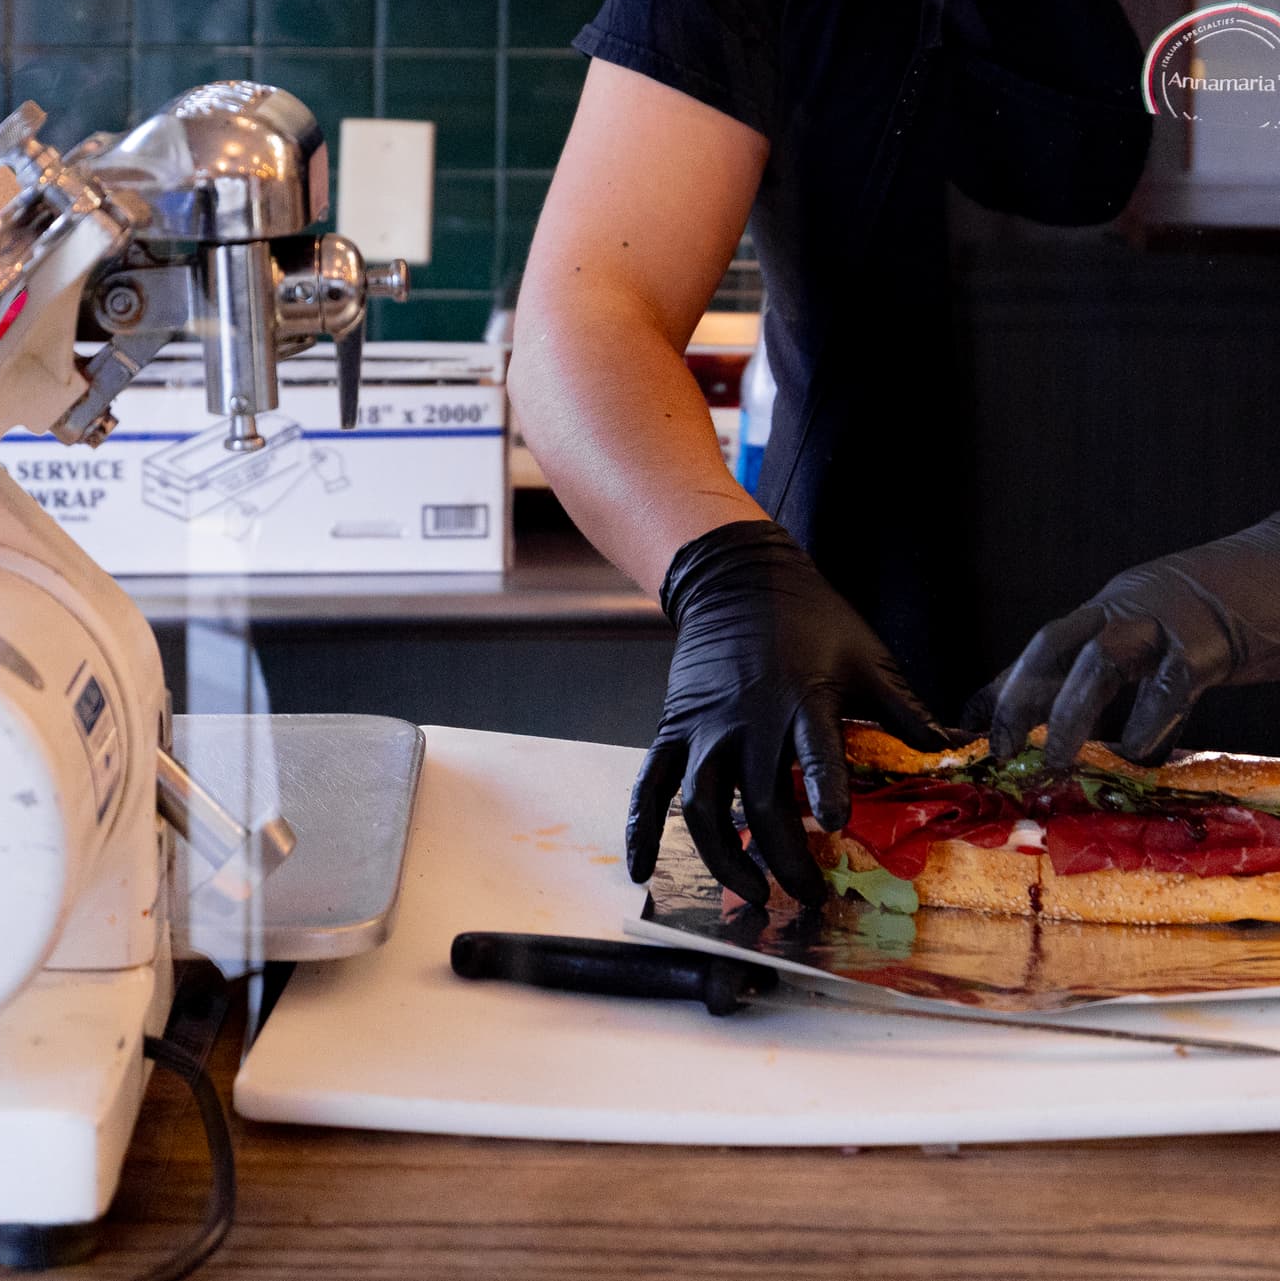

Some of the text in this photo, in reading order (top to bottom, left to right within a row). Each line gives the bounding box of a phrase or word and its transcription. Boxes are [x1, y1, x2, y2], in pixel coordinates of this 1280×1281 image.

[1161, 17, 1236, 68] ITALIAN SPECIALTIES
[402, 409, 414, 424] x
[17, 459, 124, 481] SERVICE
